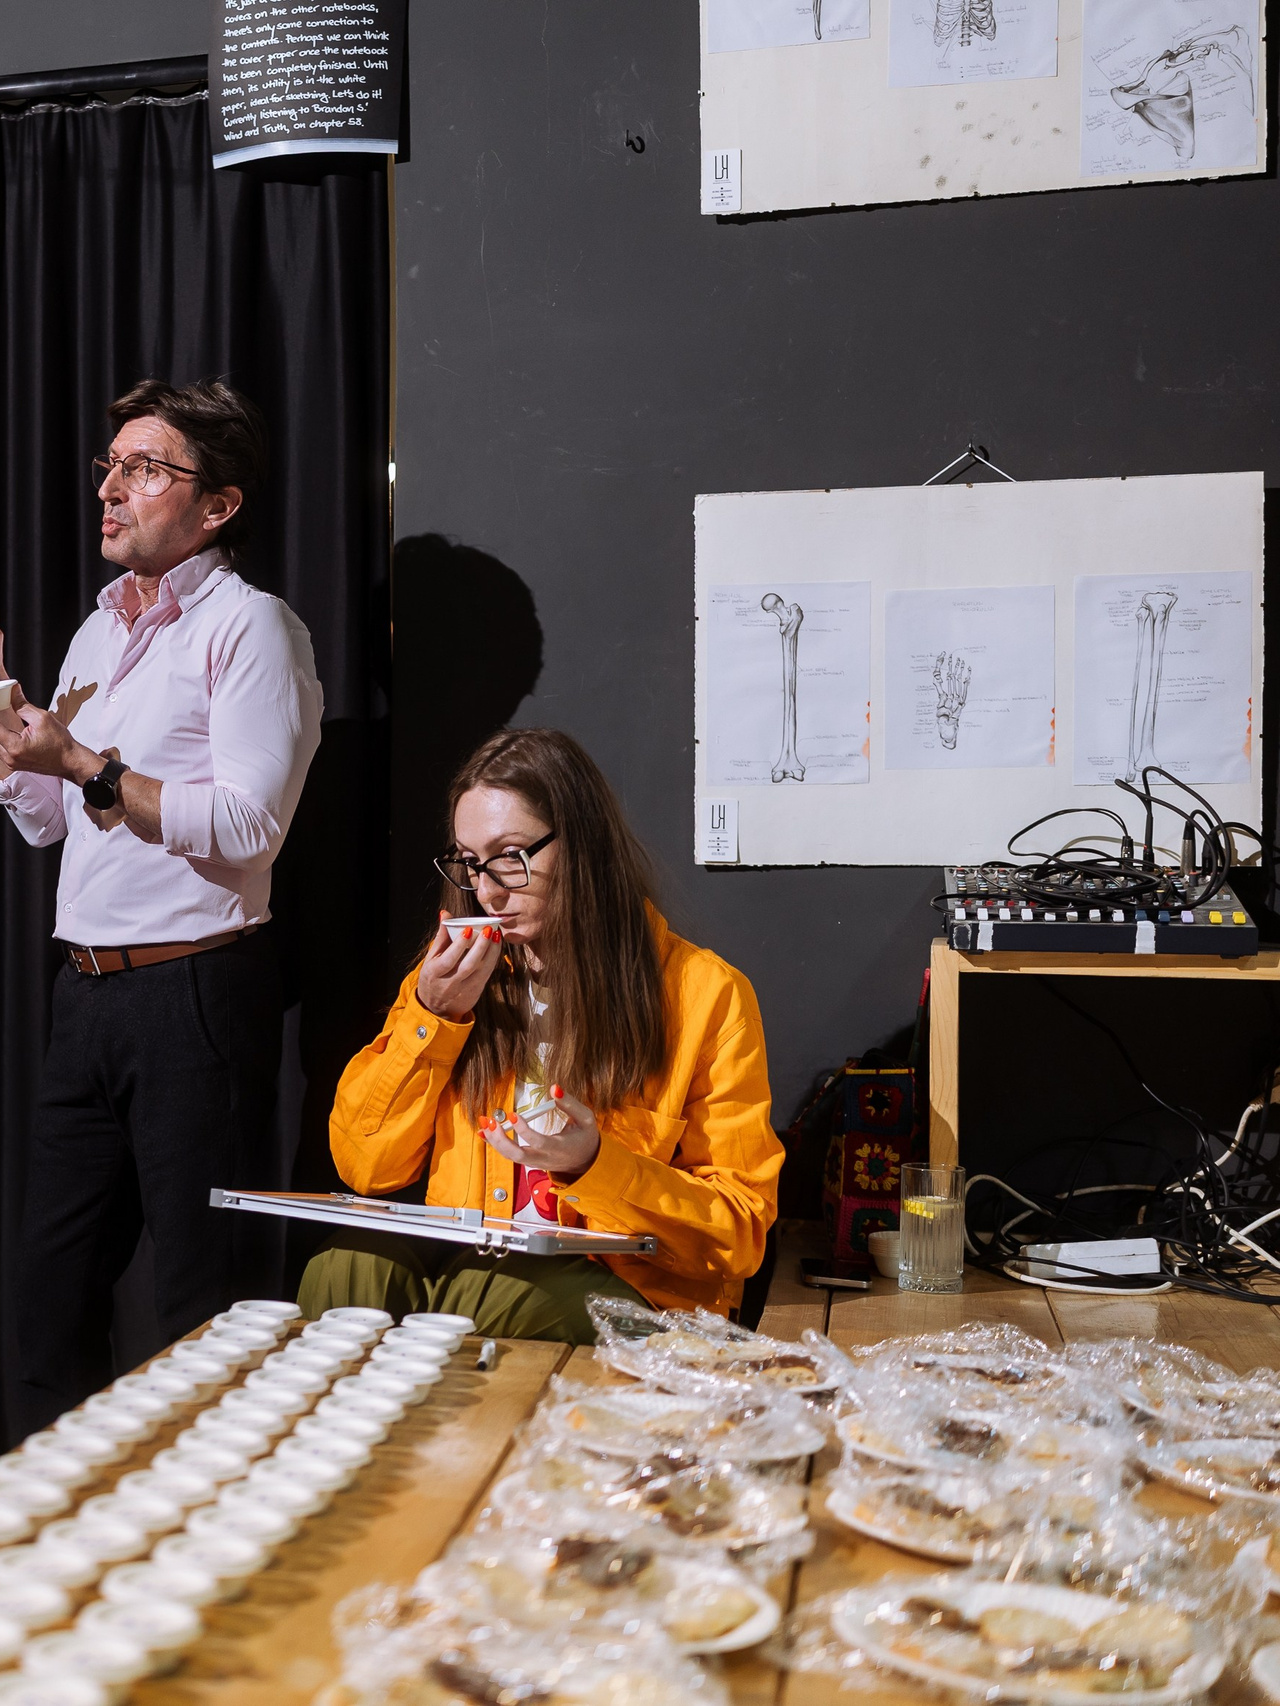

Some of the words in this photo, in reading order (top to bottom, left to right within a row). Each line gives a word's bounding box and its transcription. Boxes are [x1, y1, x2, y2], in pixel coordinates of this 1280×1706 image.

[224, 13, 252, 23] covers
[255, 11, 268, 19] on
[270, 8, 287, 16] the
[291, 5, 319, 14] other
[322, 3, 378, 13] notebooks,
[256, 24, 275, 38] only
[276, 21, 302, 30] some
[306, 16, 359, 27] connection
[360, 17, 374, 25] to
[222, 44, 238, 52] the
[286, 34, 323, 47] Perhaps
[327, 33, 341, 41] we
[363, 30, 389, 40] think
[222, 58, 237, 66] the
[267, 50, 298, 65] proper
[299, 49, 320, 57] once
[342, 46, 388, 55] notebook
[223, 72, 238, 82] has
[241, 69, 262, 79] been
[267, 62, 317, 77] completely
[317, 60, 360, 70] finished.
[364, 60, 388, 70] Until
[221, 86, 245, 97] then,
[248, 84, 259, 92] its
[262, 79, 290, 93] utility
[293, 78, 303, 86] is
[306, 76, 315, 84] in
[316, 74, 335, 84] the
[339, 76, 366, 84] white
[221, 102, 246, 115] paper,
[250, 97, 269, 107] ideal
[269, 94, 285, 103] for
[356, 90, 369, 99] do
[372, 89, 382, 99] it!
[223, 113, 257, 127] Currently
[260, 108, 298, 121] listening
[298, 106, 310, 114] to
[312, 103, 354, 113] Brandon
[224, 130, 243, 141] Wind
[245, 127, 259, 137] and
[262, 123, 290, 134] Truth,
[310, 120, 346, 133] chapter
[348, 118, 364, 127] 58.
